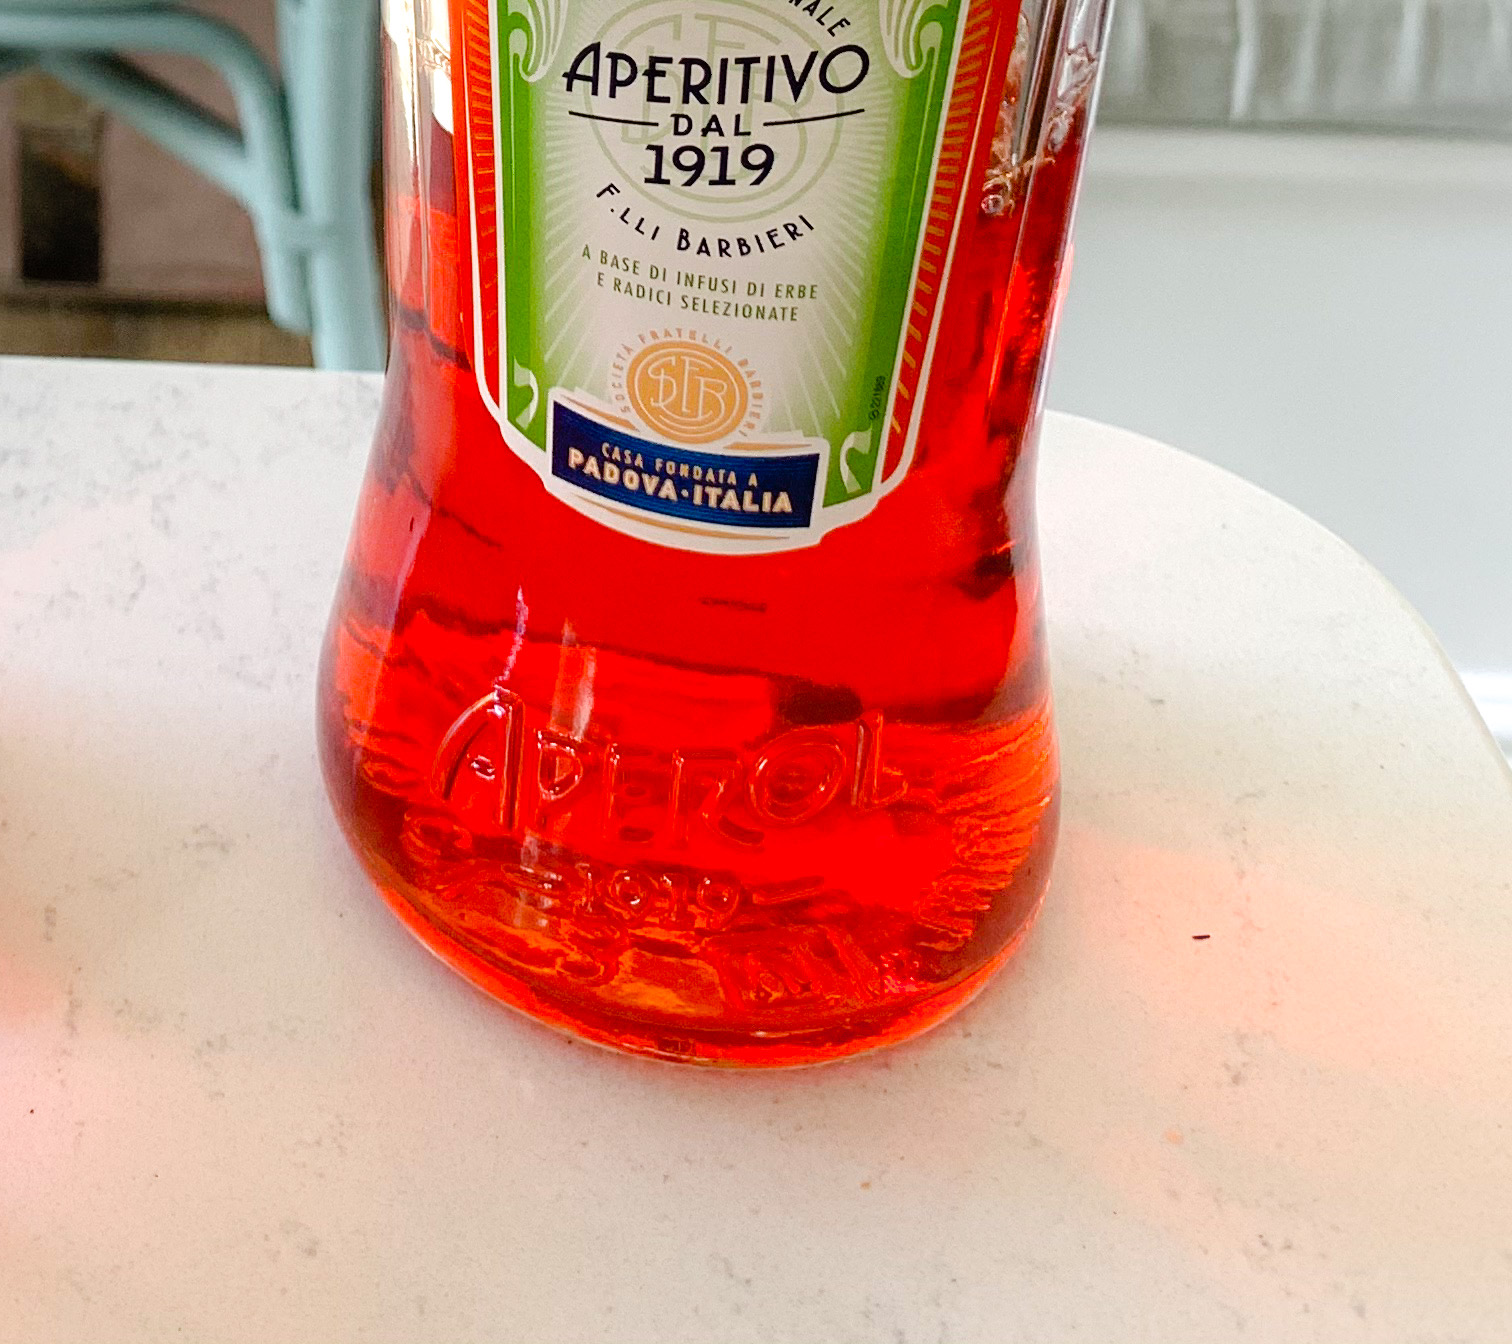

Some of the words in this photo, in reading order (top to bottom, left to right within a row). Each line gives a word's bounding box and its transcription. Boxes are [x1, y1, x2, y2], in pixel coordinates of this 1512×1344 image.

[562, 42, 870, 105] APERITIVO
[670, 113, 751, 137] DAL
[644, 143, 775, 187] 1919
[596, 183, 660, 240] F.LLI
[676, 215, 815, 258] BARBIERI
[582, 244, 591, 260] A
[600, 250, 640, 276] BASE
[649, 264, 667, 282] DI
[676, 271, 736, 294] INFUSI
[747, 282, 764, 298] DI
[775, 283, 818, 300] ERBE
[597, 272, 605, 287] E
[613, 277, 671, 306] RADICI
[680, 295, 799, 322] SELEZIONATE
[601, 442, 643, 469] CASA
[655, 458, 737, 486] FONDATA
[748, 472, 758, 487] A
